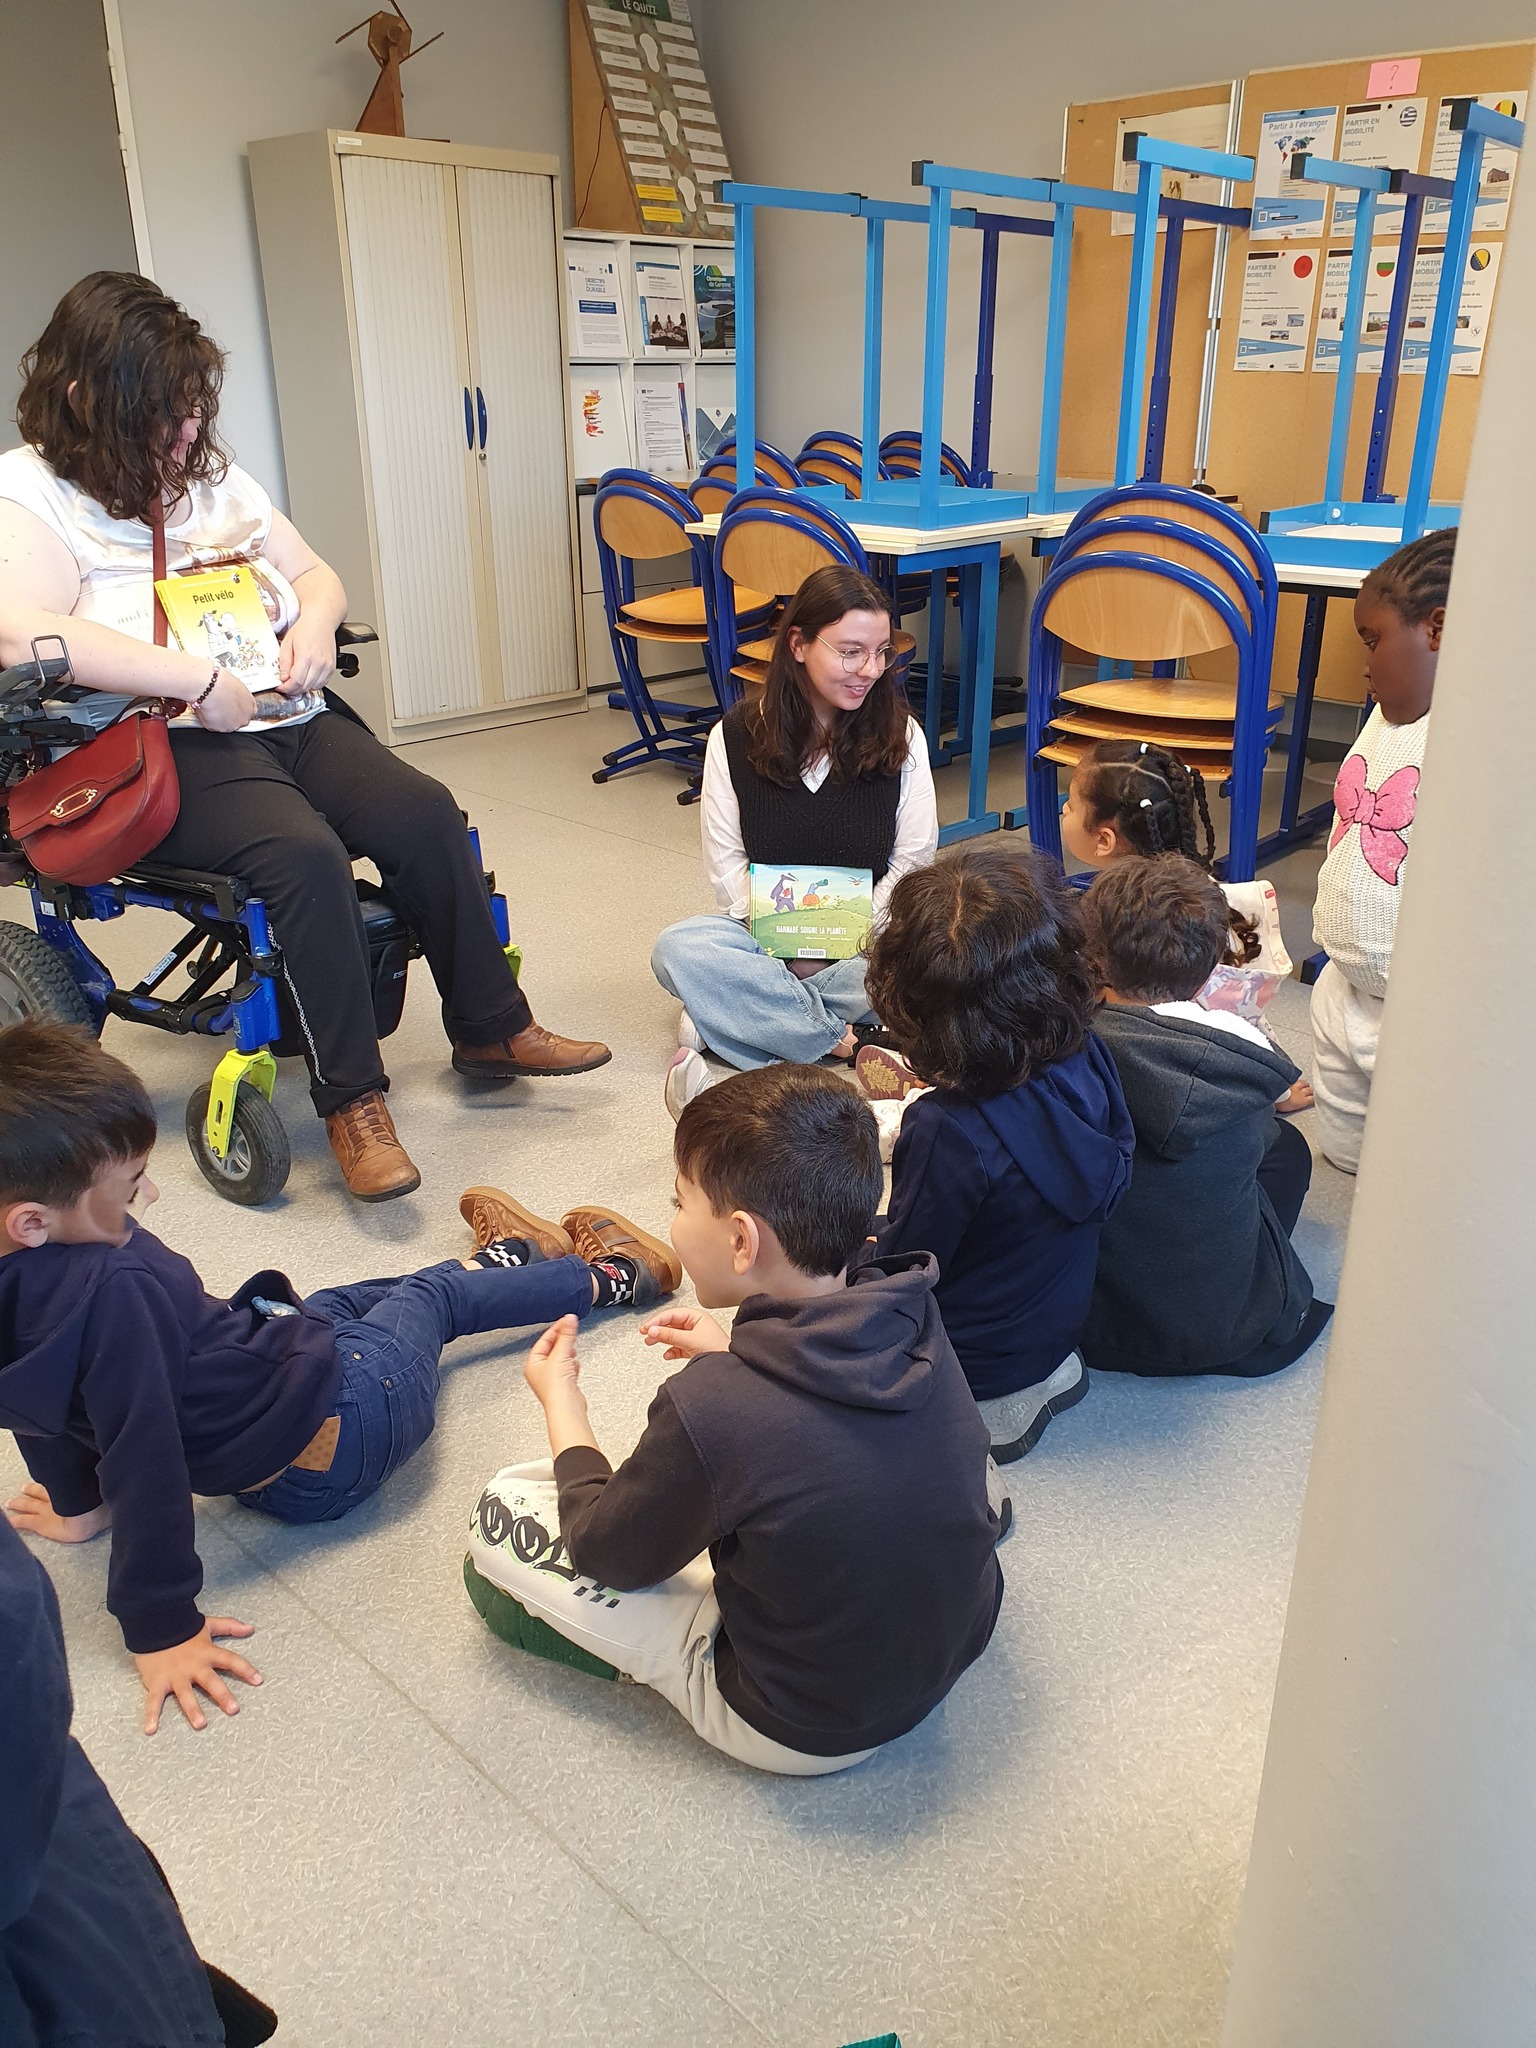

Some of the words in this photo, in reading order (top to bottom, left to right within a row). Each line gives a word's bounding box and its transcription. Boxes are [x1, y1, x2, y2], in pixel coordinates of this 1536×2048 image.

[632, 1, 657, 15] QUIZZ
[1389, 64, 1400, 90] ?
[1268, 123, 1288, 131] Partir
[1345, 119, 1370, 127] PARTIR
[1370, 117, 1381, 125] EN
[1344, 126, 1375, 135] MOBILITÉ
[1416, 259, 1441, 267] PARTIR
[193, 592, 215, 604] Petit
[214, 589, 235, 601] vélo
[776, 925, 799, 934] BARNABÉ
[800, 926, 818, 934] SOIGNE
[819, 926, 826, 934] LA
[826, 926, 847, 935] PLANÈTE
